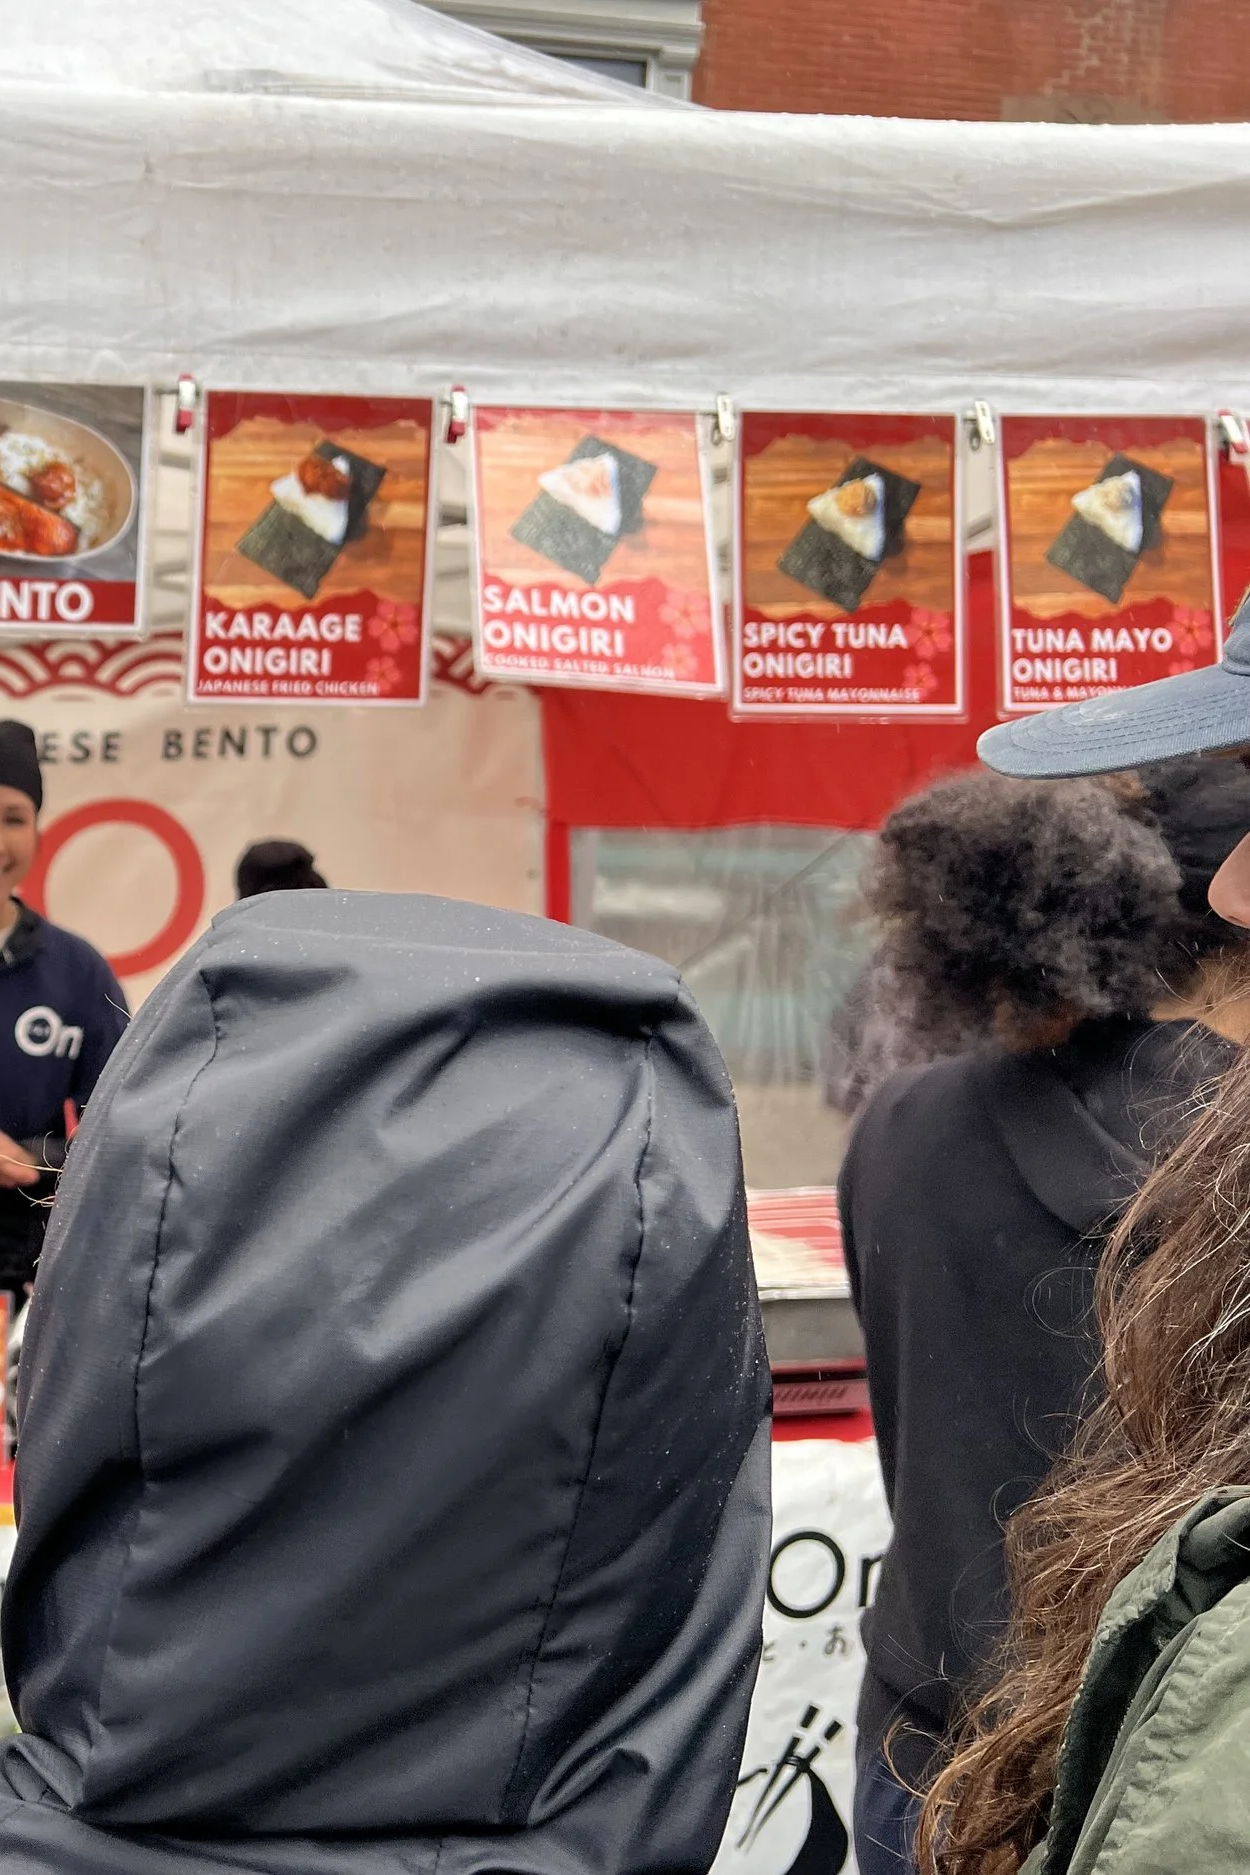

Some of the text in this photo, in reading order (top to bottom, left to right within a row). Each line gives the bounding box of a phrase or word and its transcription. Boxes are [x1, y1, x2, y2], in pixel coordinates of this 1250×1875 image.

[483, 584, 635, 624] SALMON
[205, 611, 363, 643] KARAAGE
[483, 619, 625, 658] ONIGIRI
[743, 621, 908, 649] SPICY TUNA
[1011, 627, 1174, 653] TUNA MAYO
[203, 645, 332, 677] ONIGIRI
[484, 653, 676, 680] COOKED SALTED SALMON
[743, 651, 854, 679] ONIGIRI
[1012, 656, 1119, 684] ONIGIRI
[198, 679, 380, 696] JAPANESE FRIED CHICKEN
[743, 686, 921, 702] SPICY TUNA MAYONNAISE
[1012, 686, 1049, 701] TUNA
[160, 723, 320, 762] BENTO
[14, 1005, 83, 1060] On
